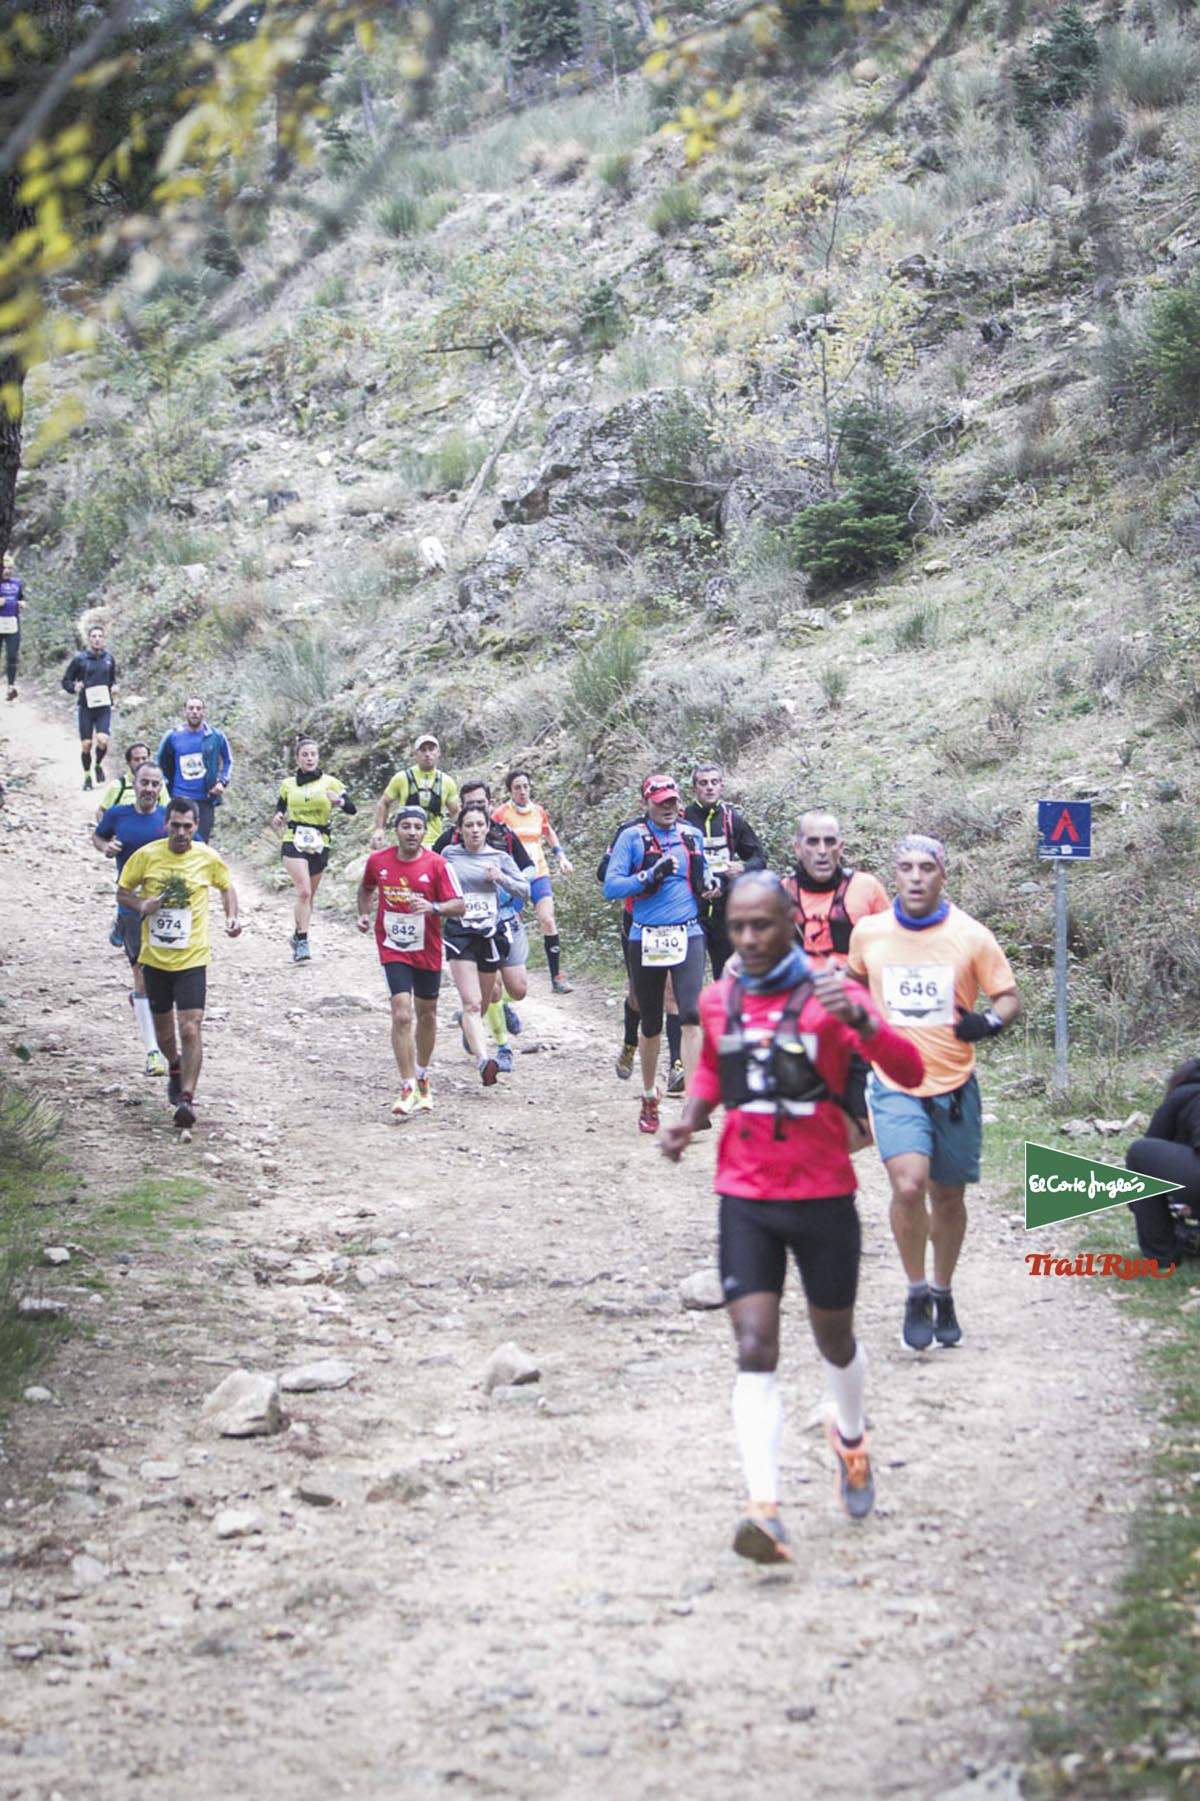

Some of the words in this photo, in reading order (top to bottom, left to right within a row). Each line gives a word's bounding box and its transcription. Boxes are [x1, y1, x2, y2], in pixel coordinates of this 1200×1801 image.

[465, 902, 489, 912] 963
[156, 918, 182, 930] 974
[391, 924, 416, 936] 842
[655, 937, 679, 948] 140
[899, 981, 938, 997] 646
